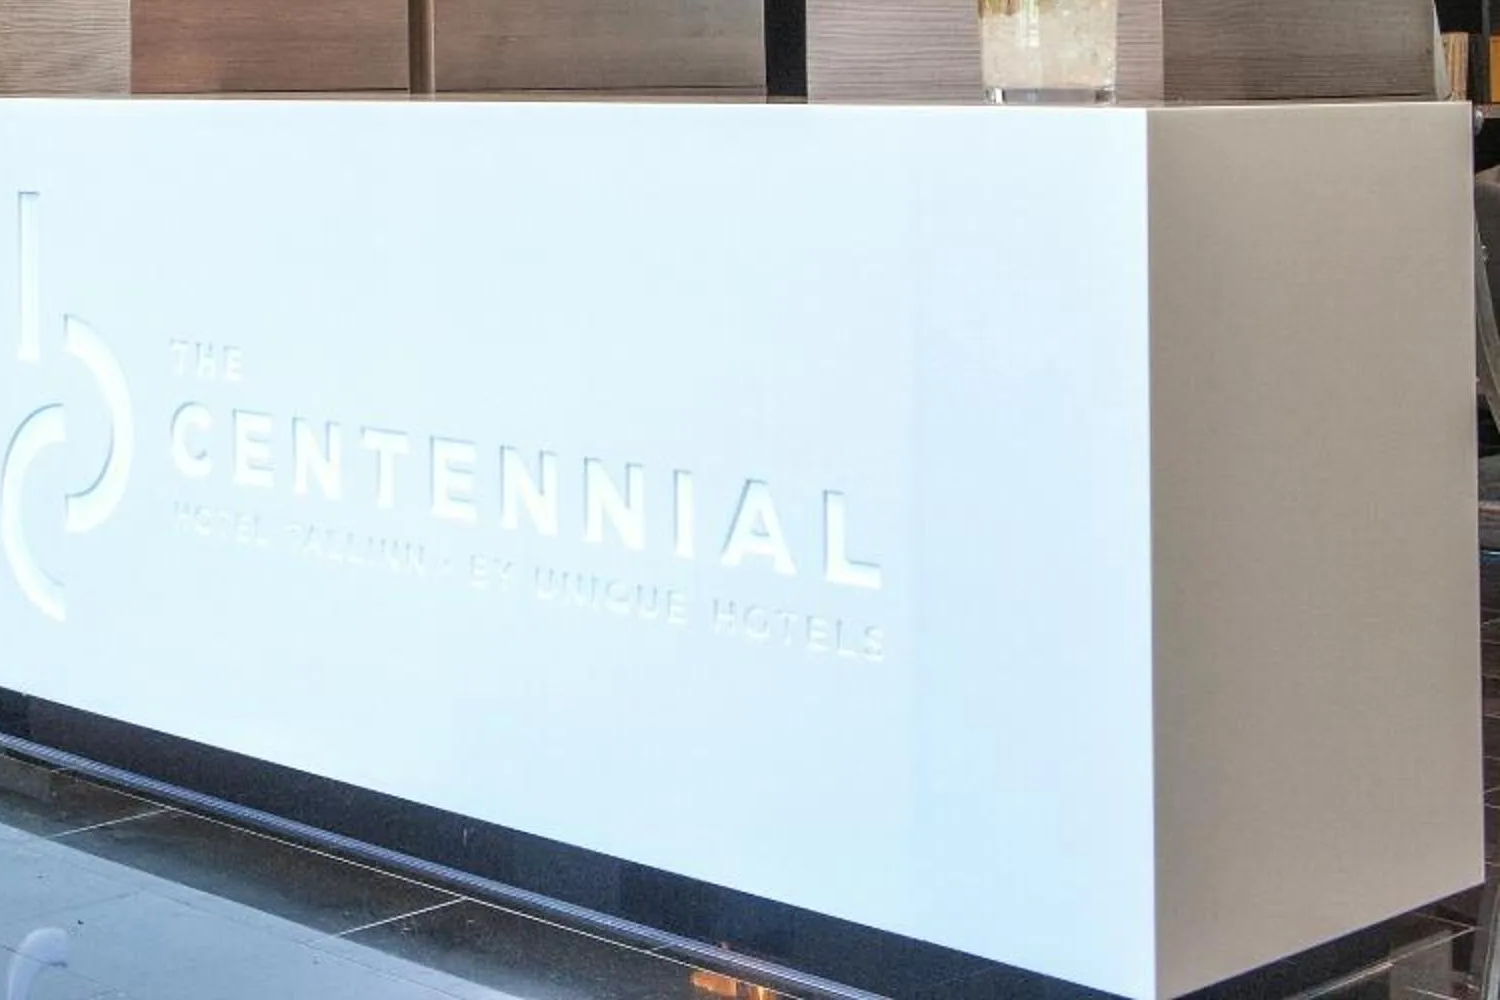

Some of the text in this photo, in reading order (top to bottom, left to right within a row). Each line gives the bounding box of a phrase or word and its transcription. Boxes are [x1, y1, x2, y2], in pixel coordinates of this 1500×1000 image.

[169, 336, 244, 382] THE
[169, 401, 882, 590] CENTENNIAL
[172, 501, 267, 545] HOTEL
[469, 552, 513, 590] BY
[534, 566, 690, 629] UNIQUE
[713, 597, 885, 663] HOTELS
